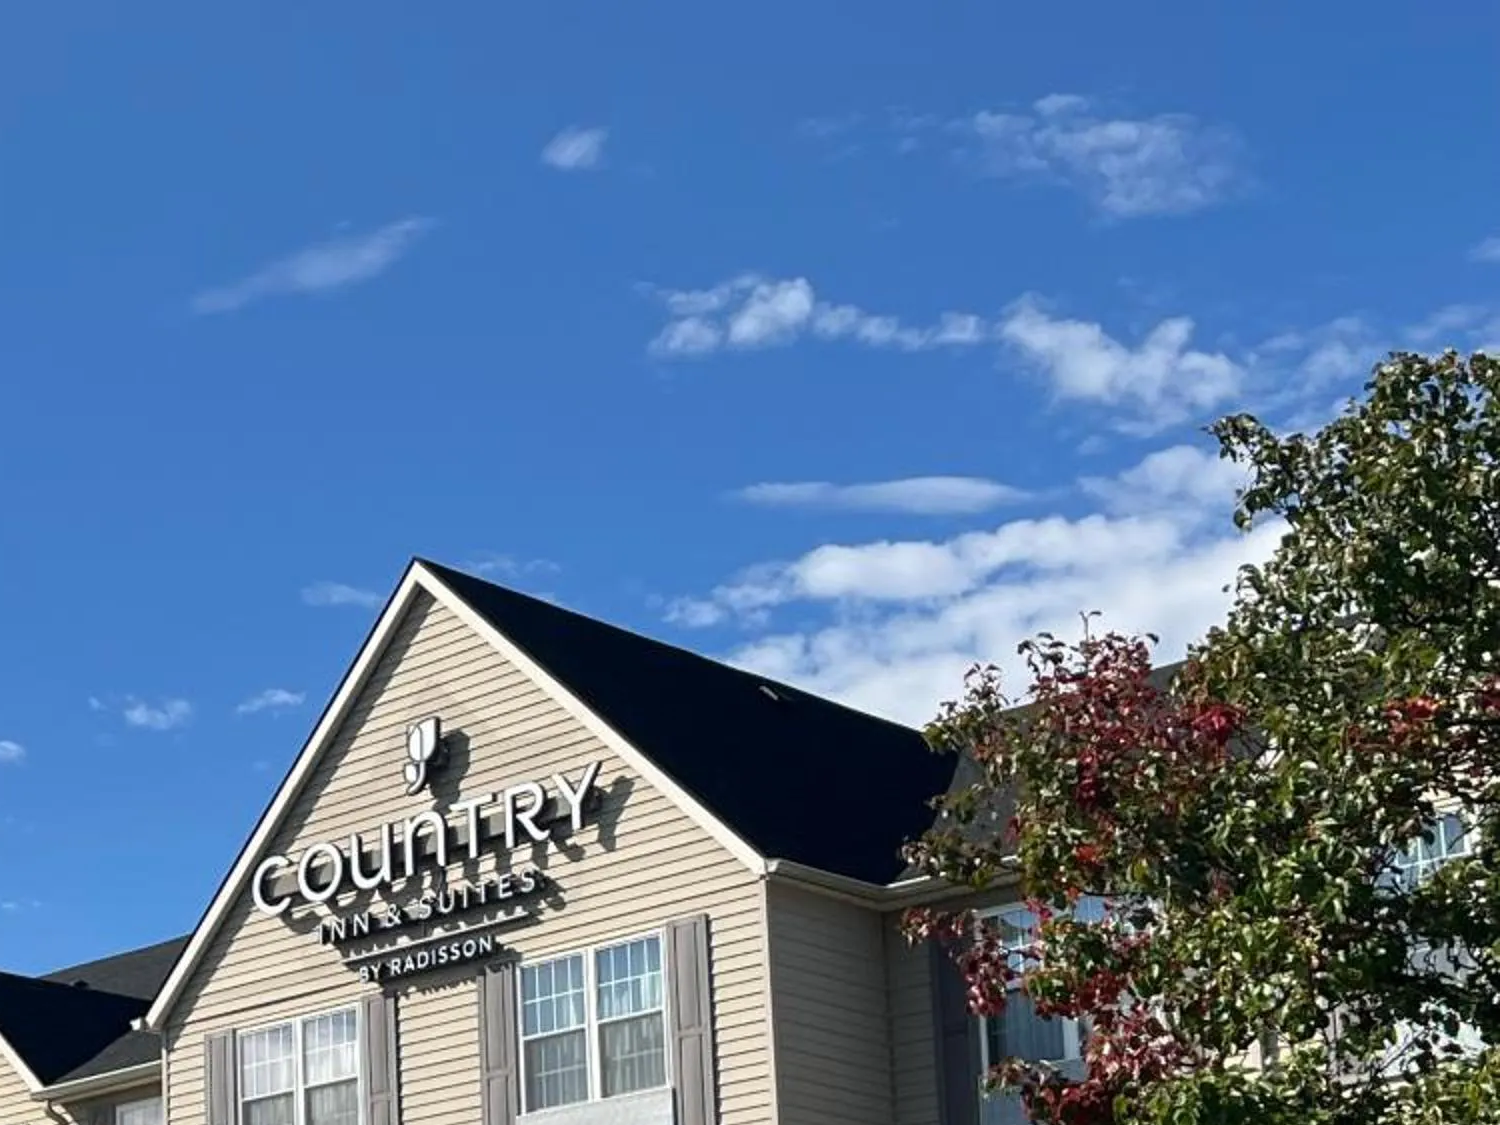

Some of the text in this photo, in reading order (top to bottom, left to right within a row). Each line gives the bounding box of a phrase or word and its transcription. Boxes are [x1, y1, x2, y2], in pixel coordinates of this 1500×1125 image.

[252, 762, 601, 917] COUNTRY
[317, 871, 536, 945] INN & SUITES
[359, 936, 493, 984] BY RADISSON
